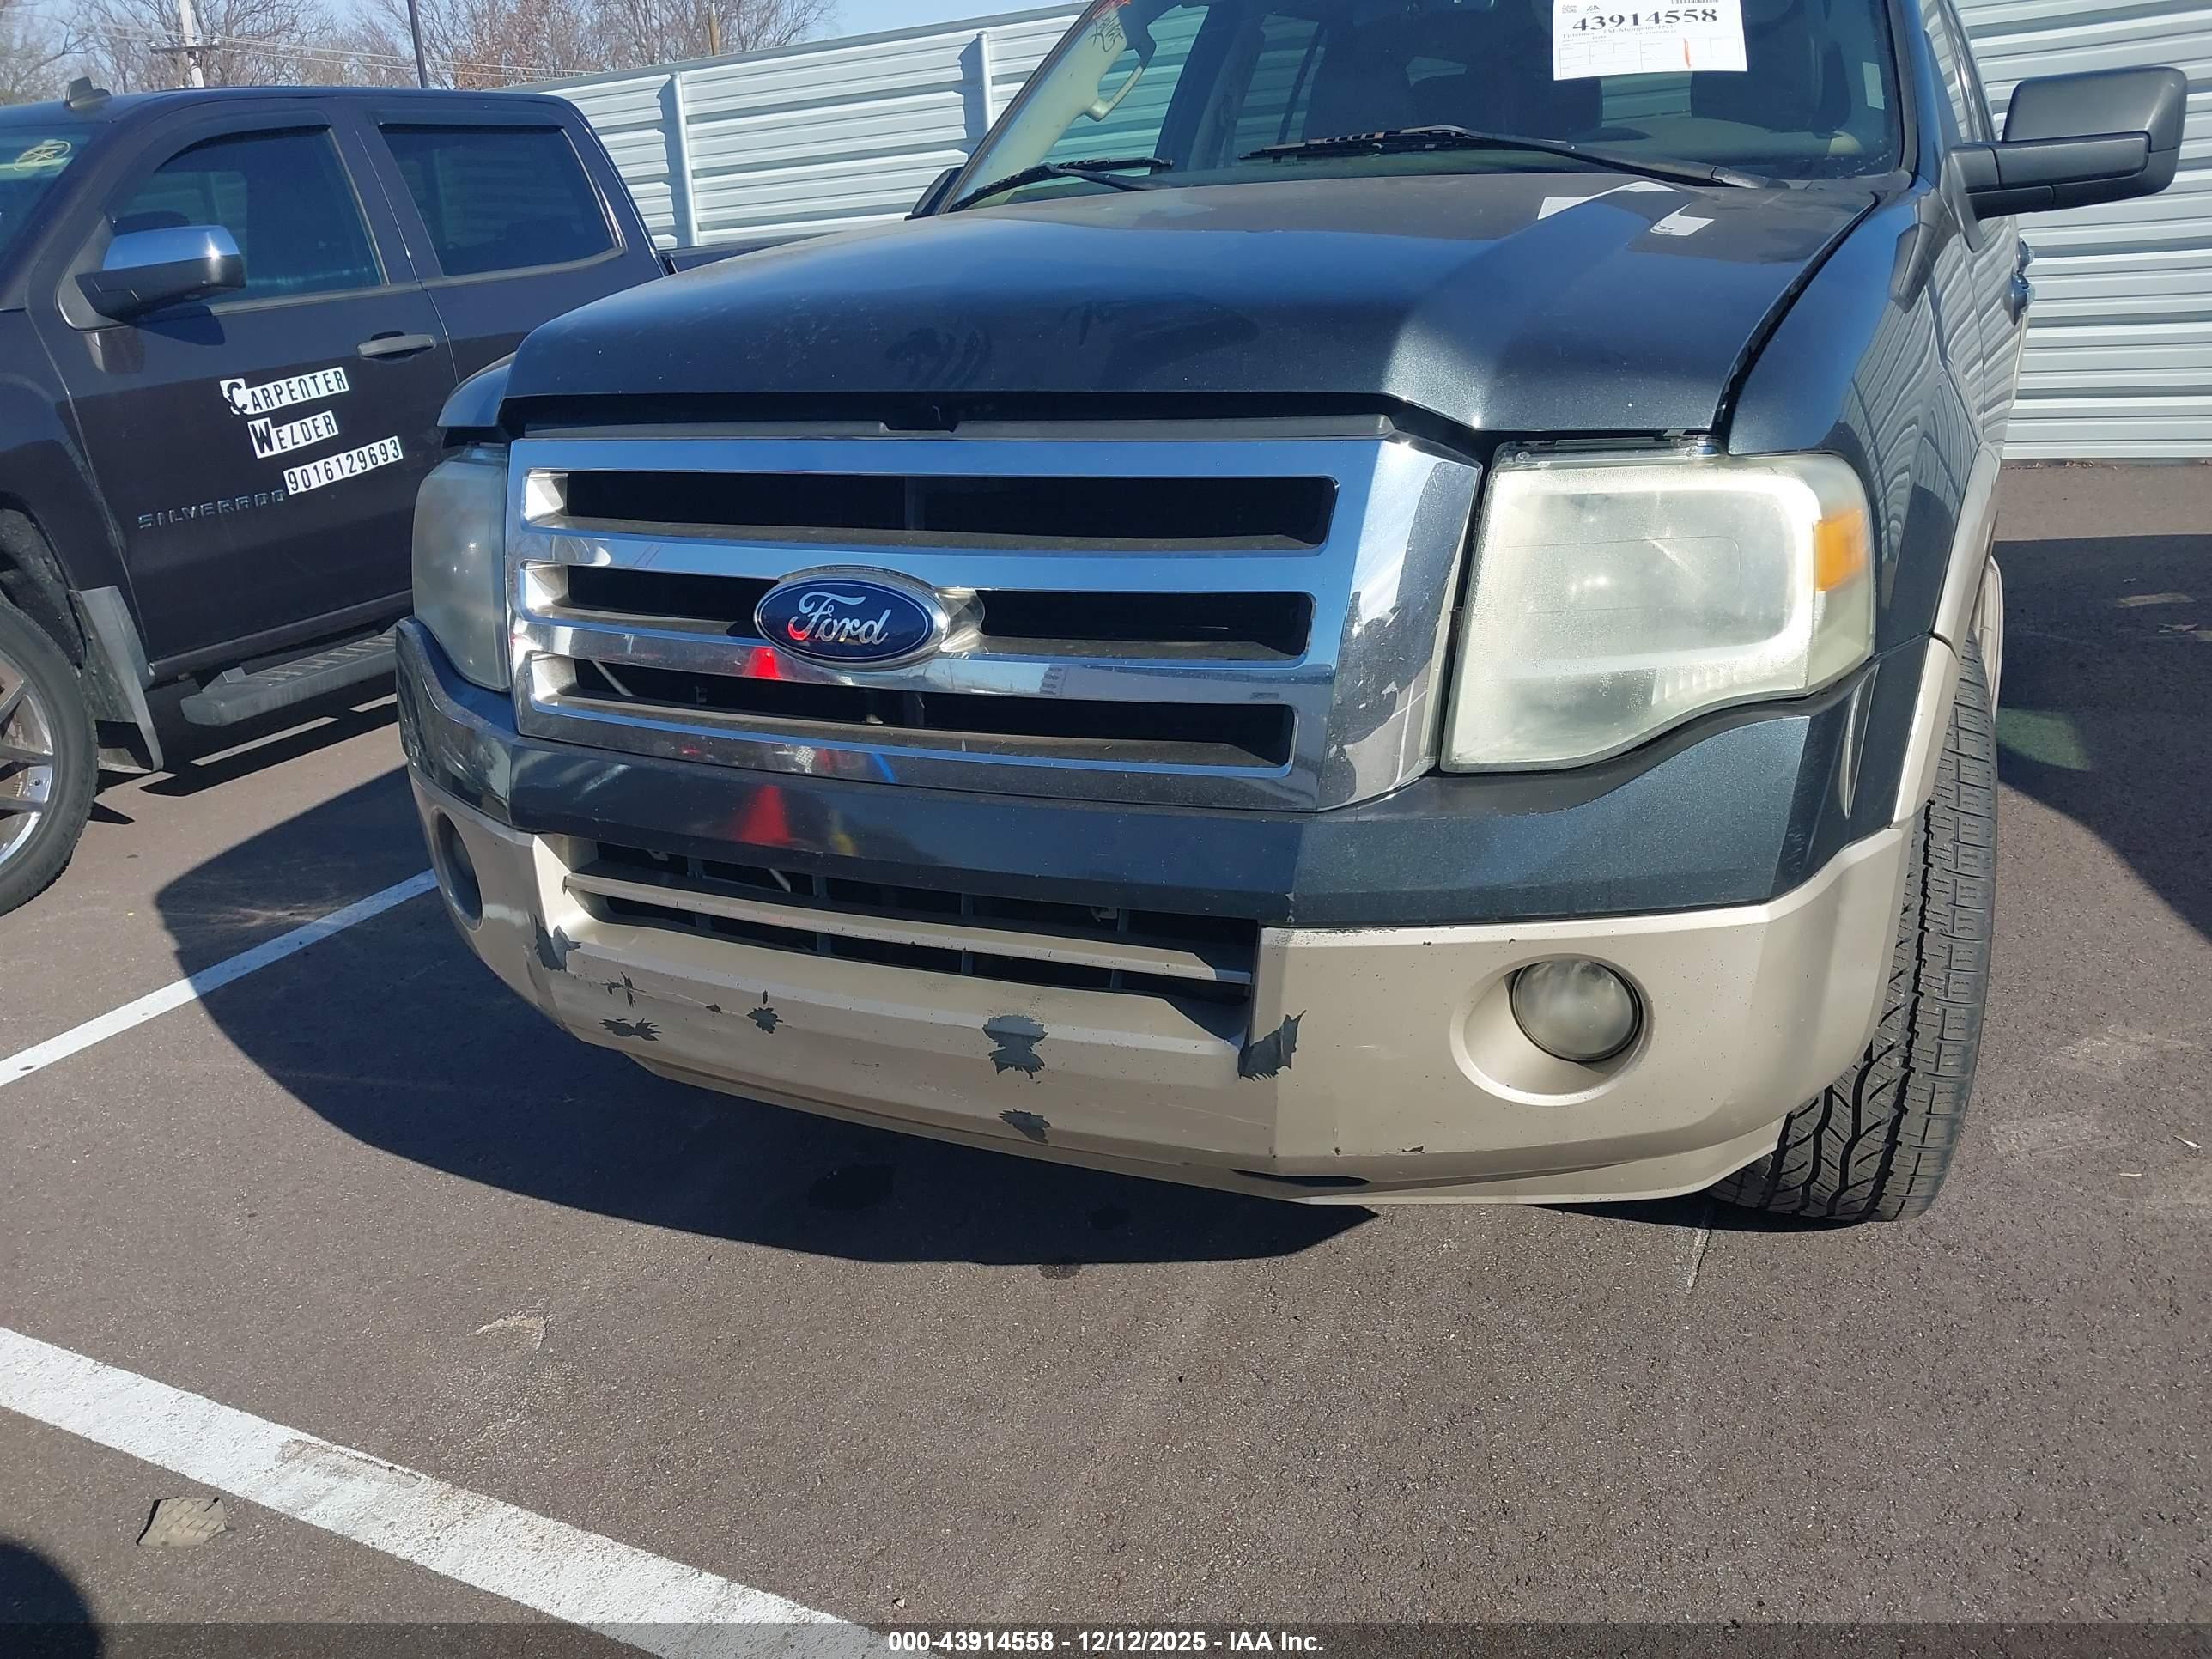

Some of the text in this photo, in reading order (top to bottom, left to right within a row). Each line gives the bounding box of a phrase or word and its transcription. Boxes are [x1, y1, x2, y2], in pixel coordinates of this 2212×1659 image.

[1572, 8, 1717, 32] 43914558
[287, 438, 402, 493] 9016129693
[137, 489, 286, 529] SILVERADO
[787, 591, 892, 645] Ford
